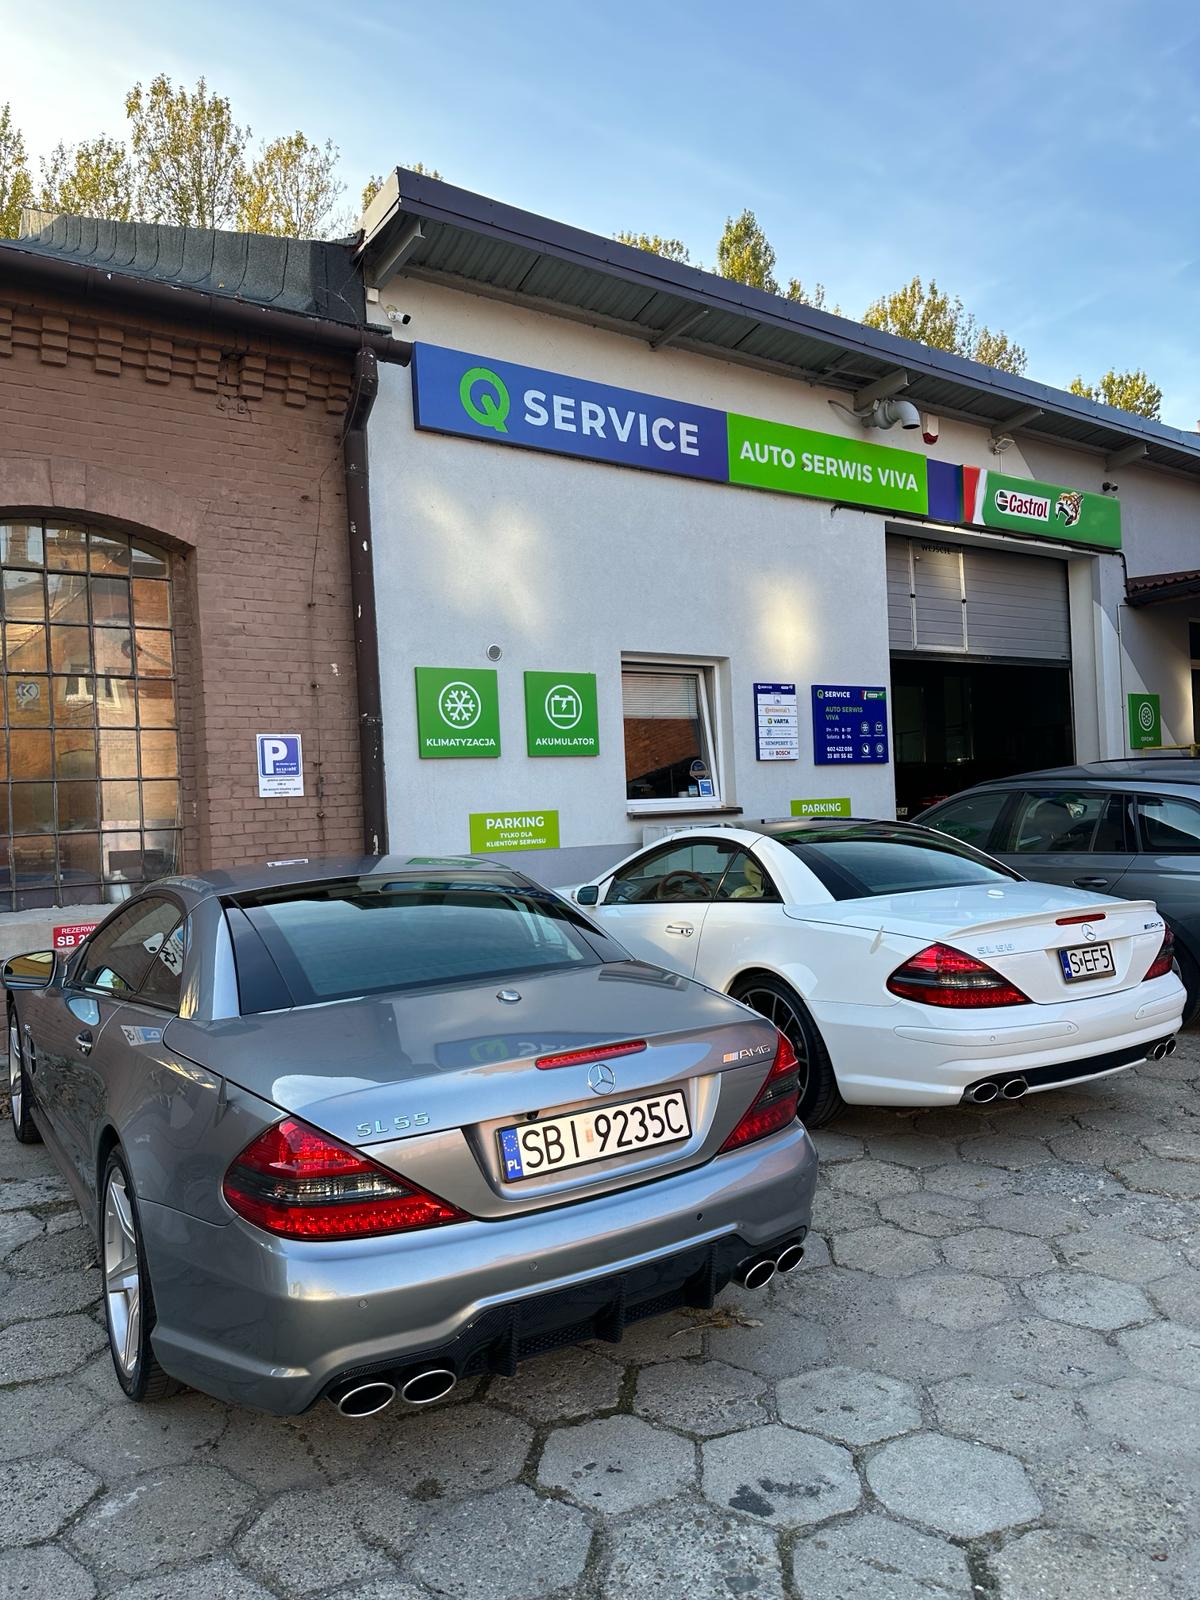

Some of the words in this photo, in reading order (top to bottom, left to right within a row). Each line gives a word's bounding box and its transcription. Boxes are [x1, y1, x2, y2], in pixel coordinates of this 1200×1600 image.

[459, 366, 511, 433] Q
[523, 388, 701, 457] SERVICE
[739, 439, 796, 470] AUTO
[801, 450, 874, 485] SERWIS
[877, 466, 919, 493] VIVA
[1009, 494, 1048, 519] Castrol
[824, 690, 851, 698] SERVICE
[426, 736, 496, 747] KLIMATYZACJA
[535, 736, 595, 746] AKUMULATOR
[263, 739, 288, 774] P
[801, 802, 842, 814] PARKING
[486, 815, 545, 830] PARKING
[486, 839, 518, 848] KLIENTÓW
[519, 838, 547, 846] SERWISU
[57, 935, 75, 946] SB
[78, 933, 89, 945] 2
[1069, 951, 1081, 974] S
[1082, 947, 1110, 972] EF5
[739, 1043, 771, 1059] AMG
[507, 1159, 521, 1172] PL
[521, 1128, 580, 1169] SBI
[593, 1098, 686, 1153] 9235C
